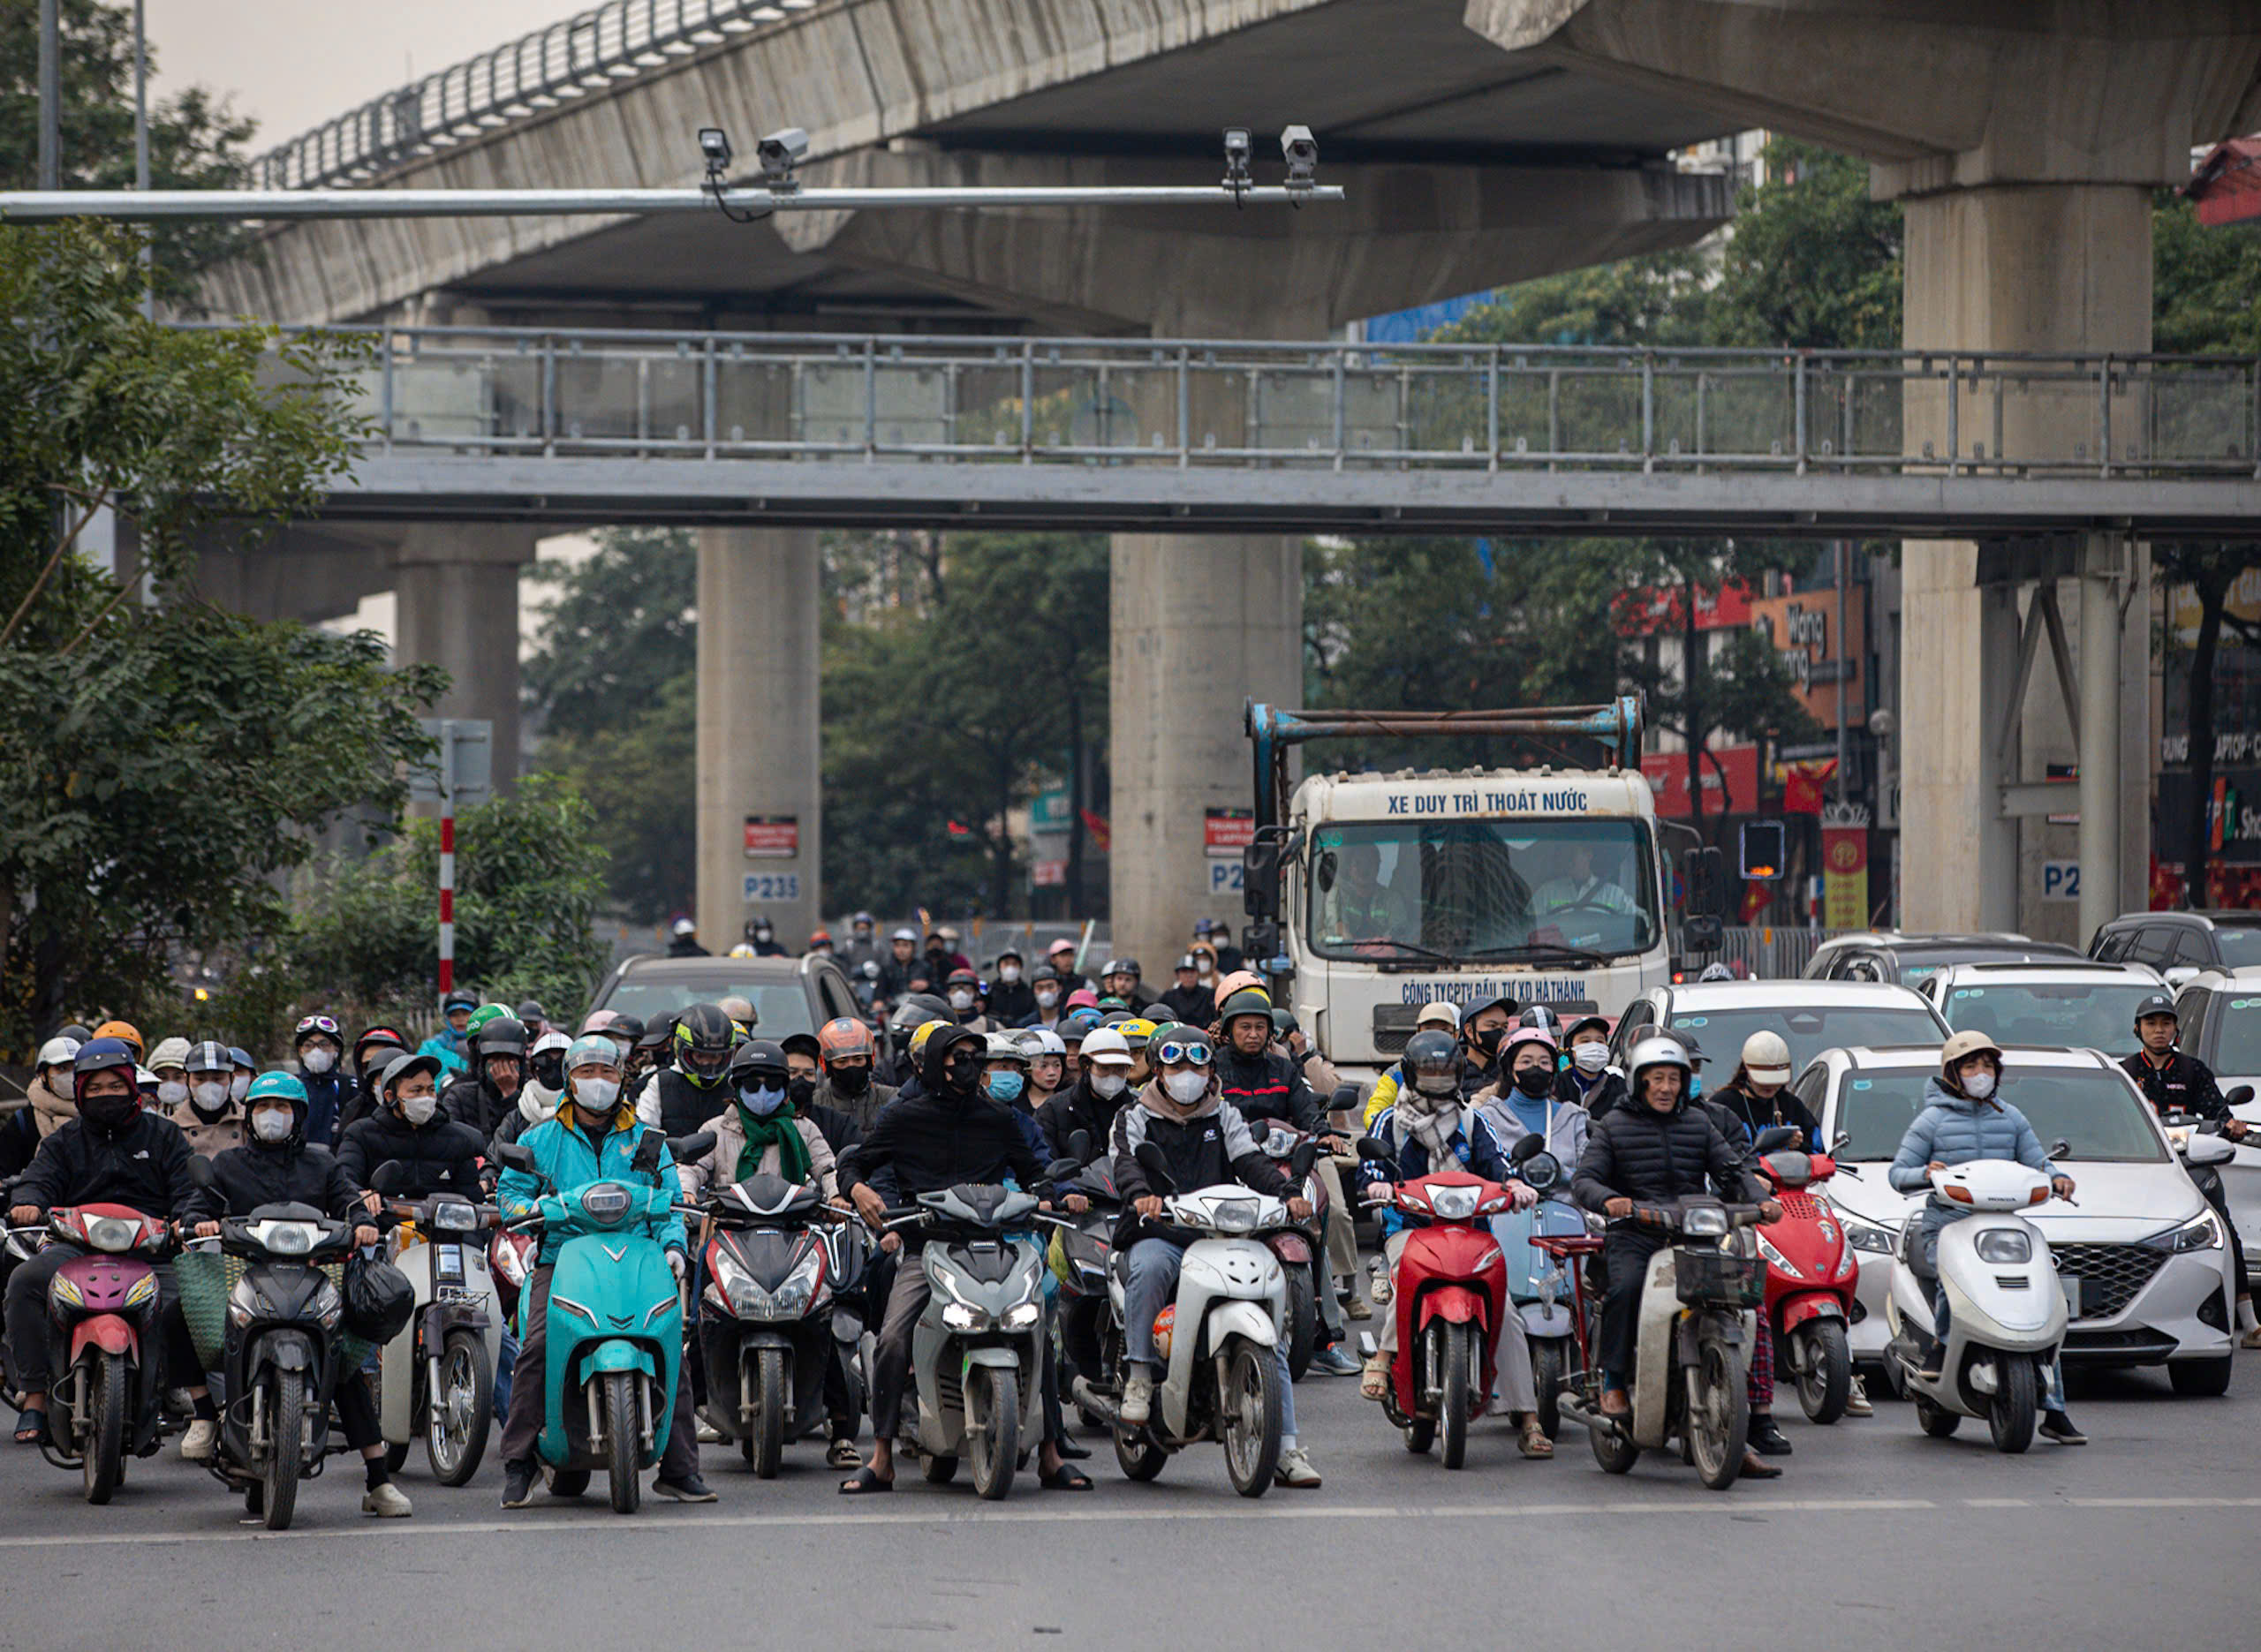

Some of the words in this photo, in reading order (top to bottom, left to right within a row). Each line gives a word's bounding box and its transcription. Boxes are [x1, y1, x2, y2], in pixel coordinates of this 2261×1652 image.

[1787, 604, 1826, 659] Wang
[2212, 733, 2248, 761] APTOP
[1388, 795, 1409, 814] XE
[1415, 794, 1447, 813] DUY
[1453, 789, 1478, 812] TRÌ
[1486, 788, 1537, 811] THOÁT
[1543, 788, 1587, 811] NƯỚC
[745, 876, 798, 898] P235
[1403, 979, 1431, 1004] CÔNG
[1518, 981, 1532, 1002] XD
[1550, 977, 1585, 1003] THÀNH
[1123, 1023, 1140, 1032] be
